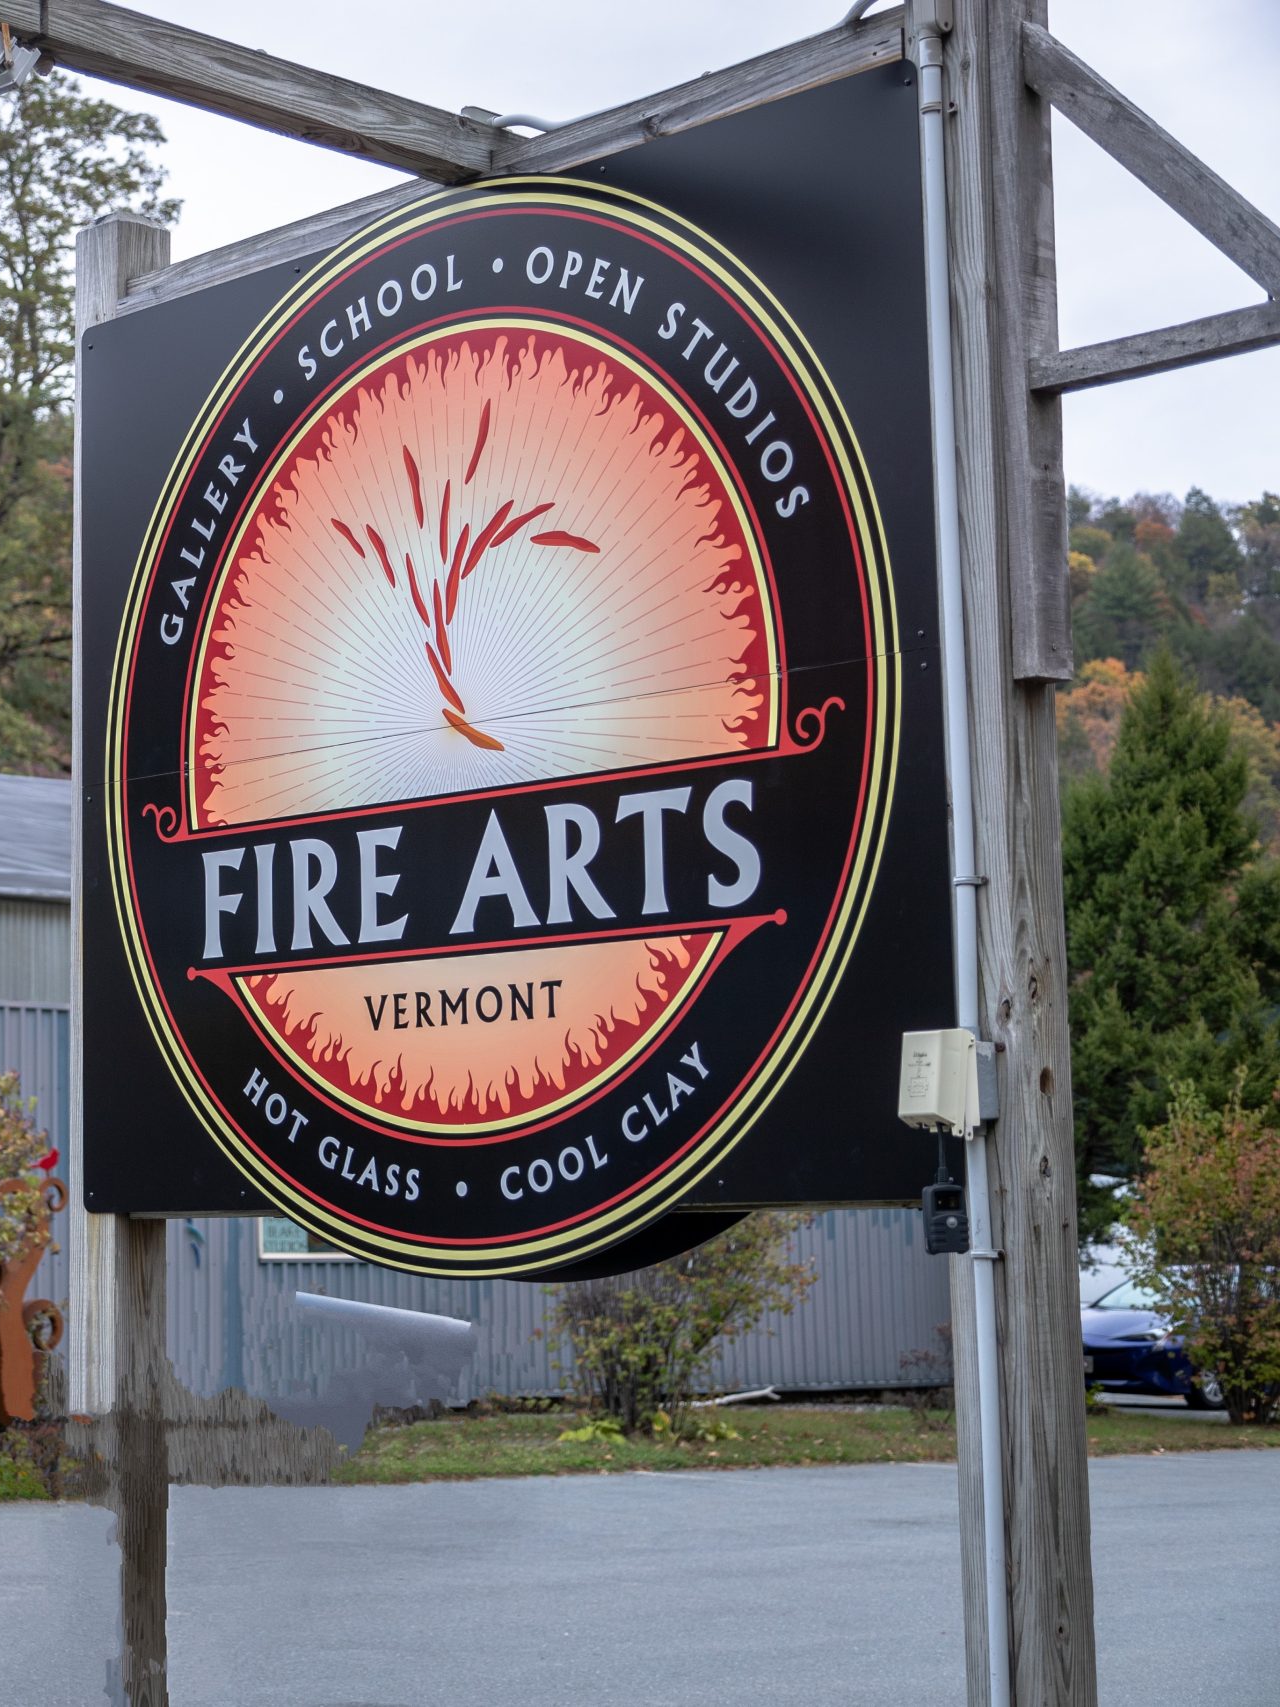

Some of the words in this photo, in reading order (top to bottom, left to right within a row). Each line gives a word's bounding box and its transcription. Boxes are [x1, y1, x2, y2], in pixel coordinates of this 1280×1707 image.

[160, 417, 260, 645] GALLERY
[297, 254, 464, 381] SCHOOL
[525, 245, 646, 316] OPEN
[657, 302, 810, 518] STUDIOS
[202, 826, 410, 960] FIRE
[448, 779, 762, 935] ARTS
[363, 979, 564, 1032] VERMONT
[242, 1067, 310, 1144] HOT
[317, 1136, 421, 1201] GLASS
[500, 1135, 609, 1201] COOL
[621, 1040, 710, 1142] CLAY
